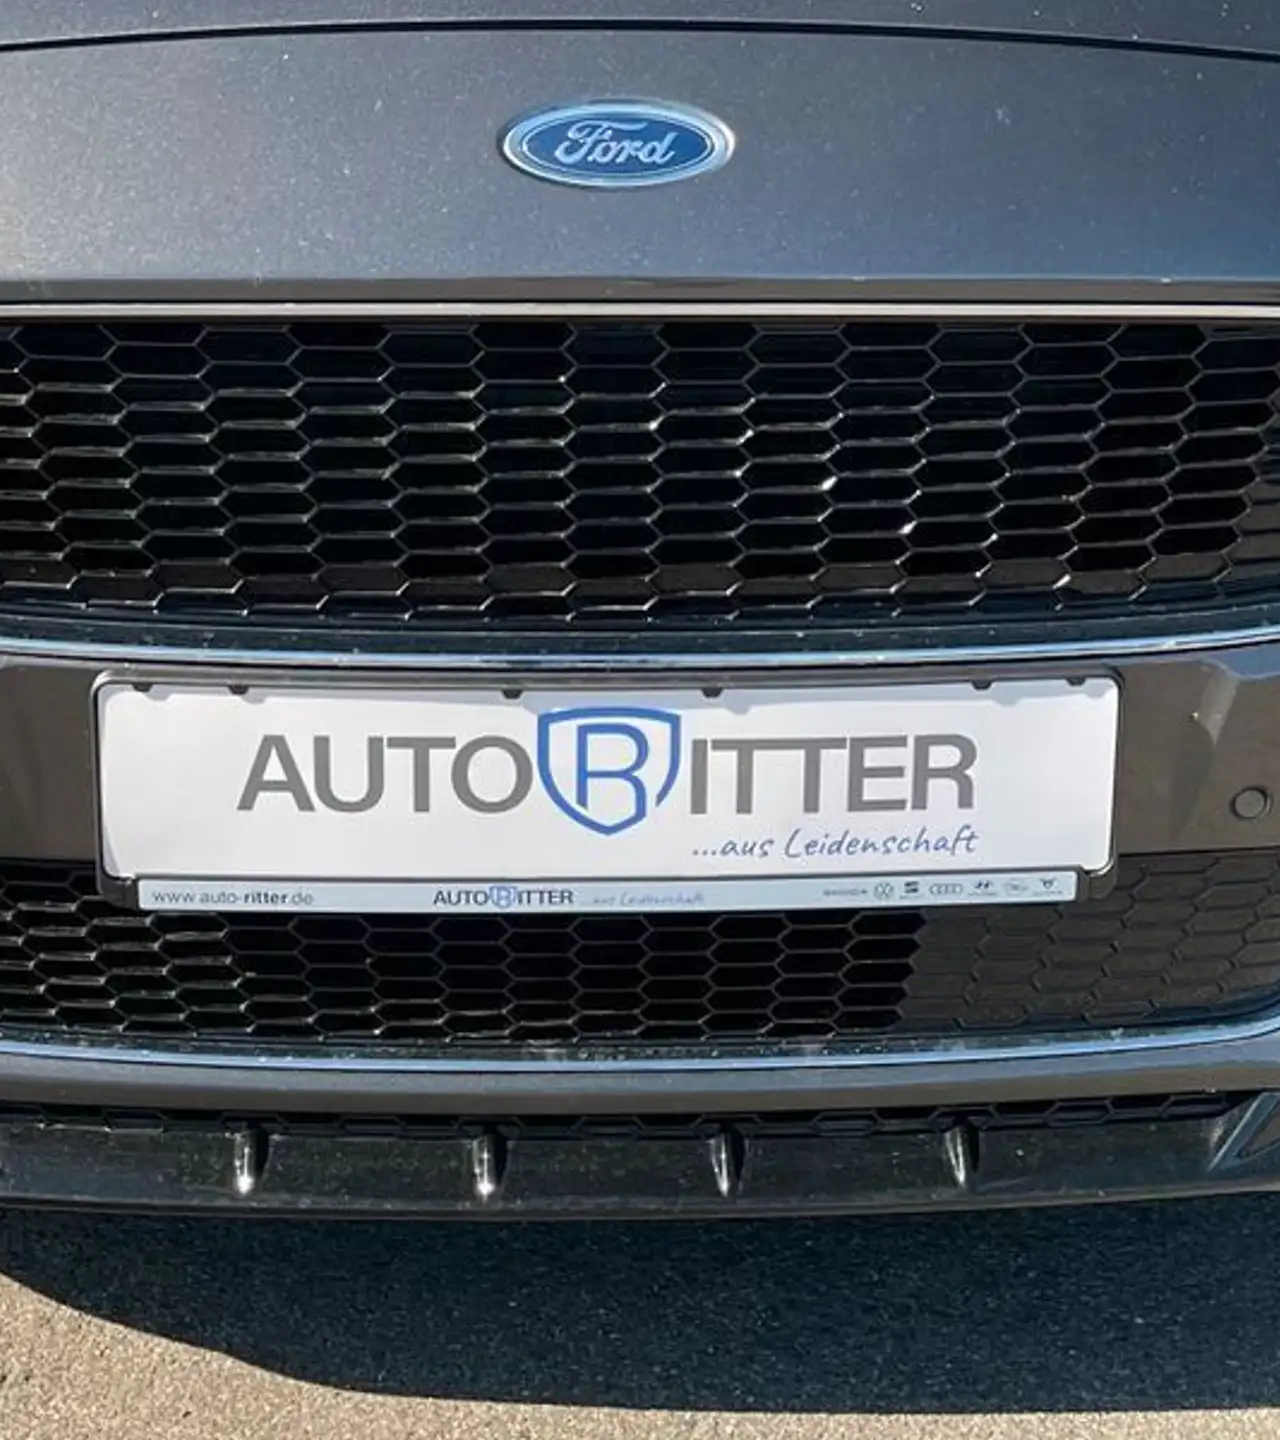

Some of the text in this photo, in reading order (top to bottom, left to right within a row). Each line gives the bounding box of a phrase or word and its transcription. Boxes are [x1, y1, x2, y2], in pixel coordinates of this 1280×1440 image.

[554, 120, 675, 164] Ford
[784, 824, 979, 858] Leidenschaft
[151, 891, 315, 906] www.auto-ritter.de
